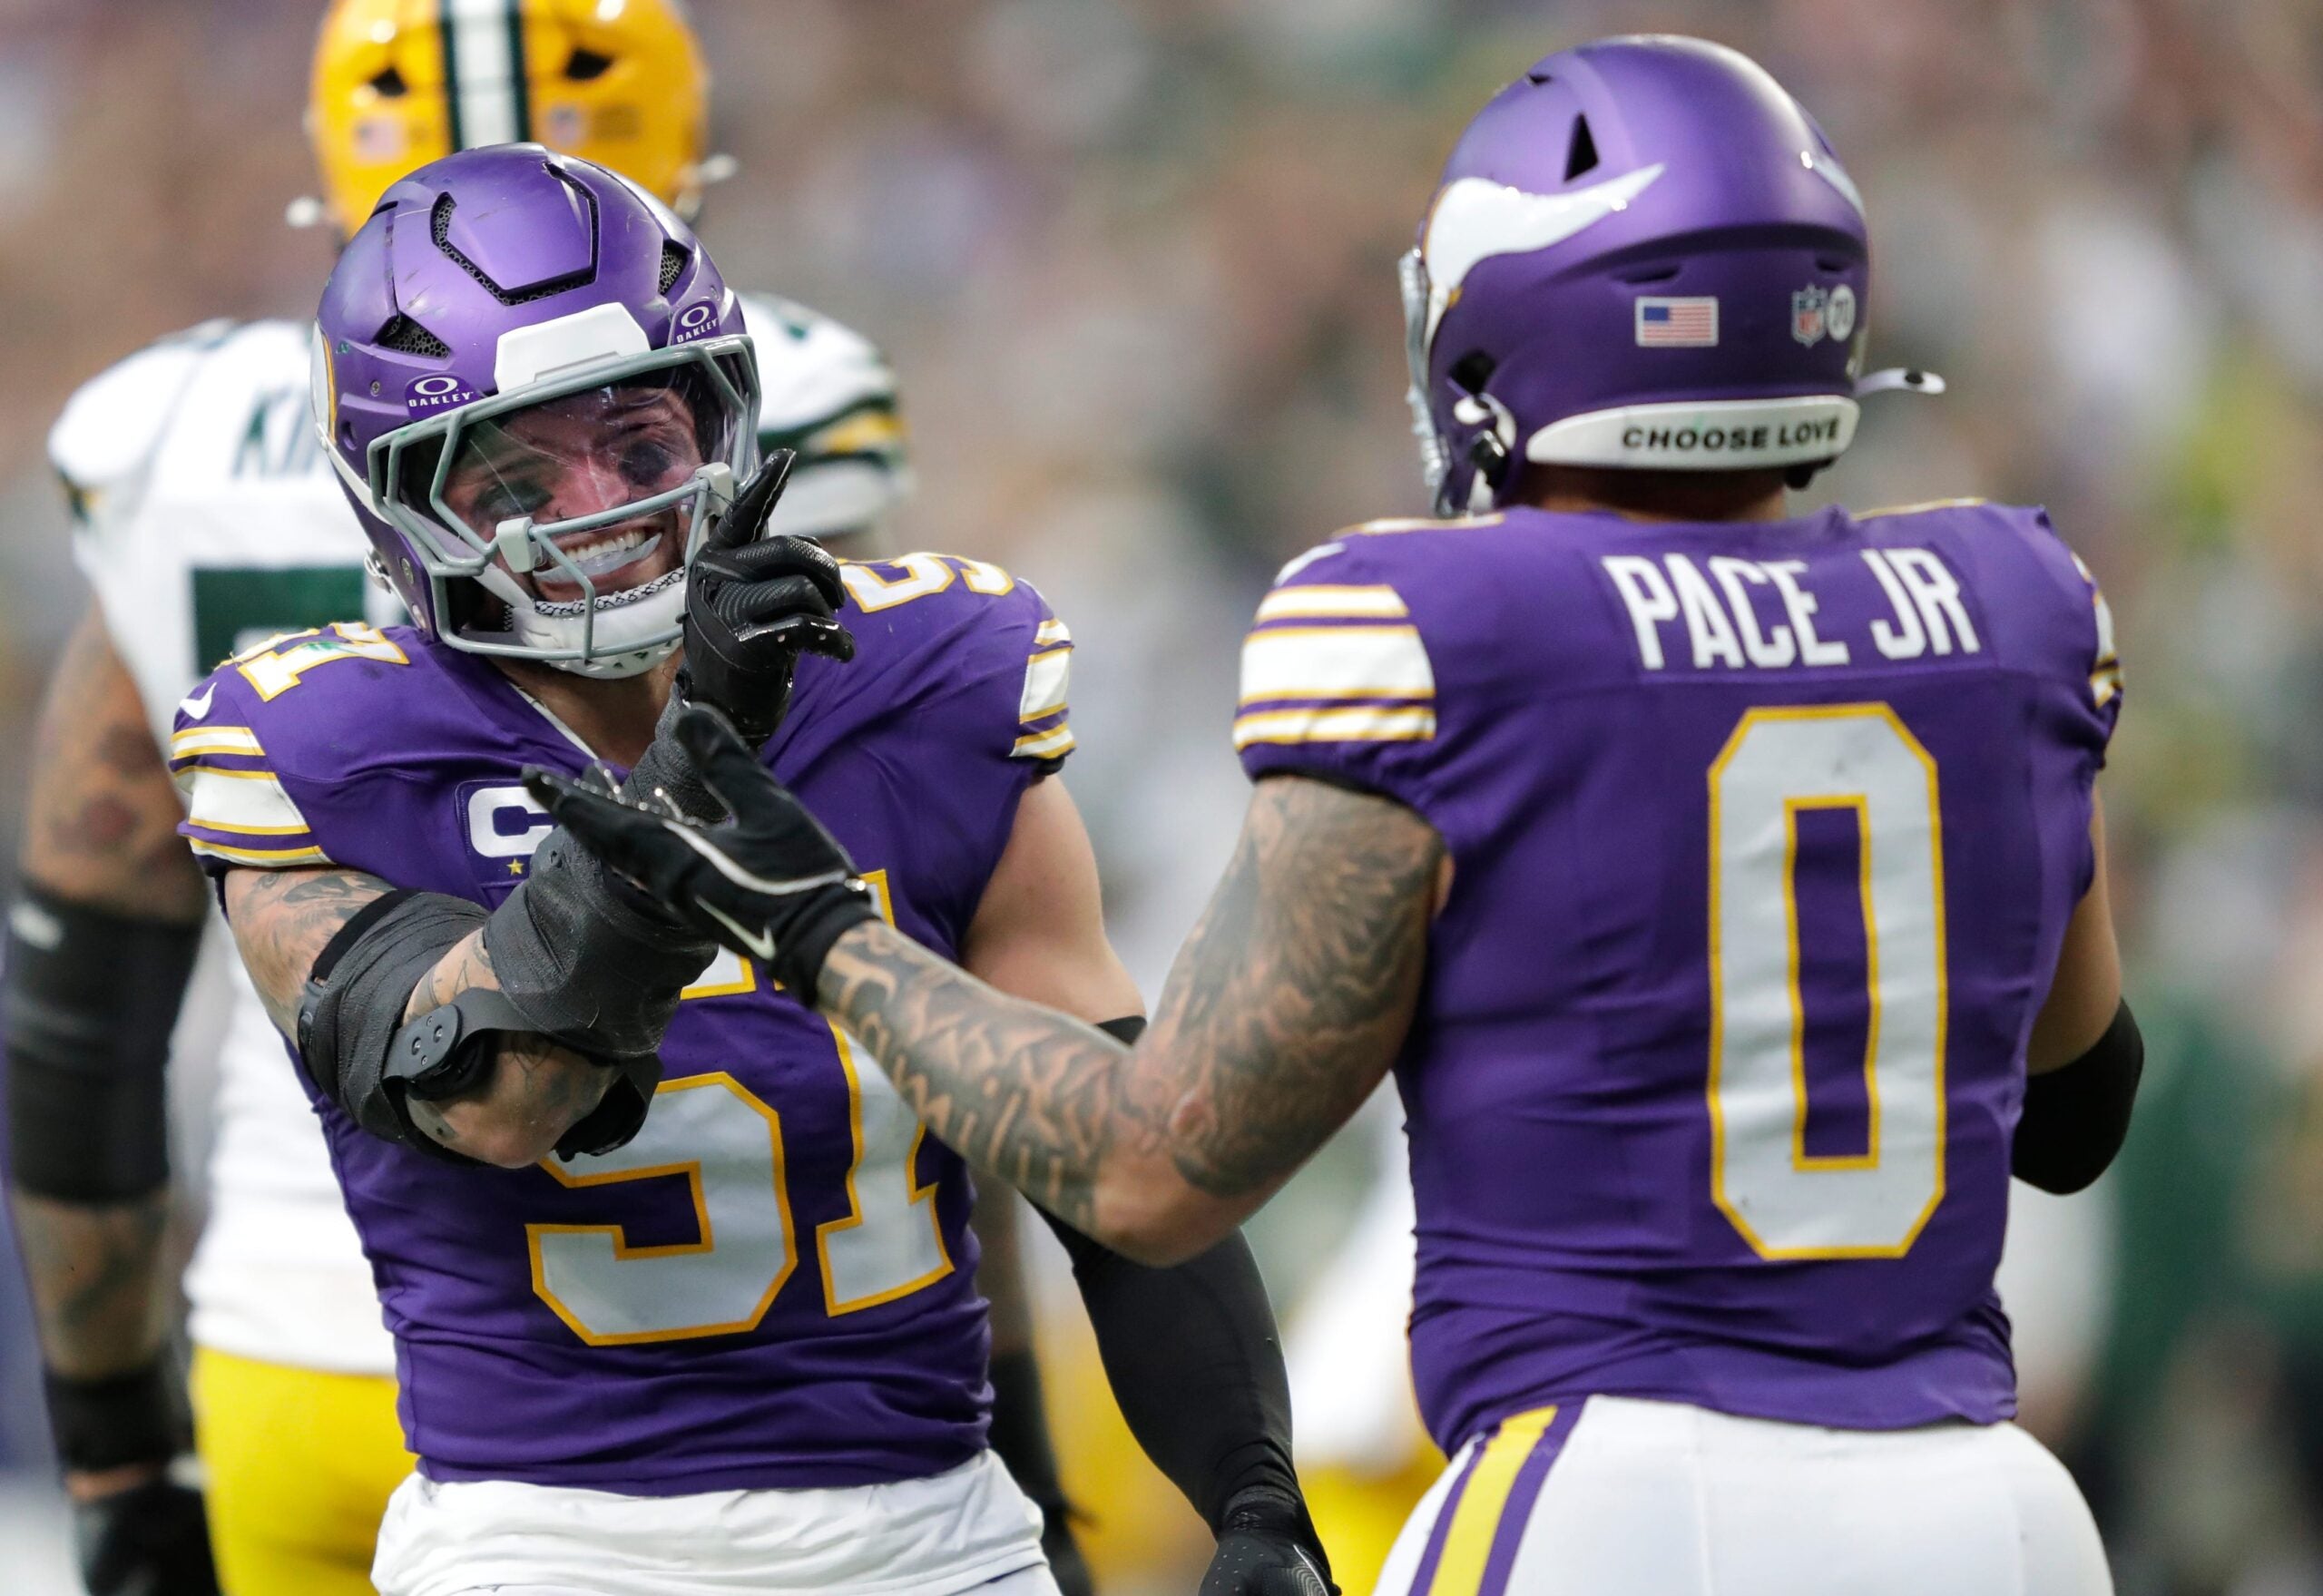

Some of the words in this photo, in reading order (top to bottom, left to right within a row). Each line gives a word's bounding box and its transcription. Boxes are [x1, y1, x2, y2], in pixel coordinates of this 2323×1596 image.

[676, 318, 718, 343] OAKLEY
[408, 391, 472, 407] OAKLEY
[1622, 426, 1769, 449] CHOOSE
[1778, 416, 1838, 446] LOVE
[1602, 553, 1849, 670] PACE
[1861, 548, 1981, 660] JR
[468, 787, 554, 857] C
[1707, 701, 1948, 1260] 0
